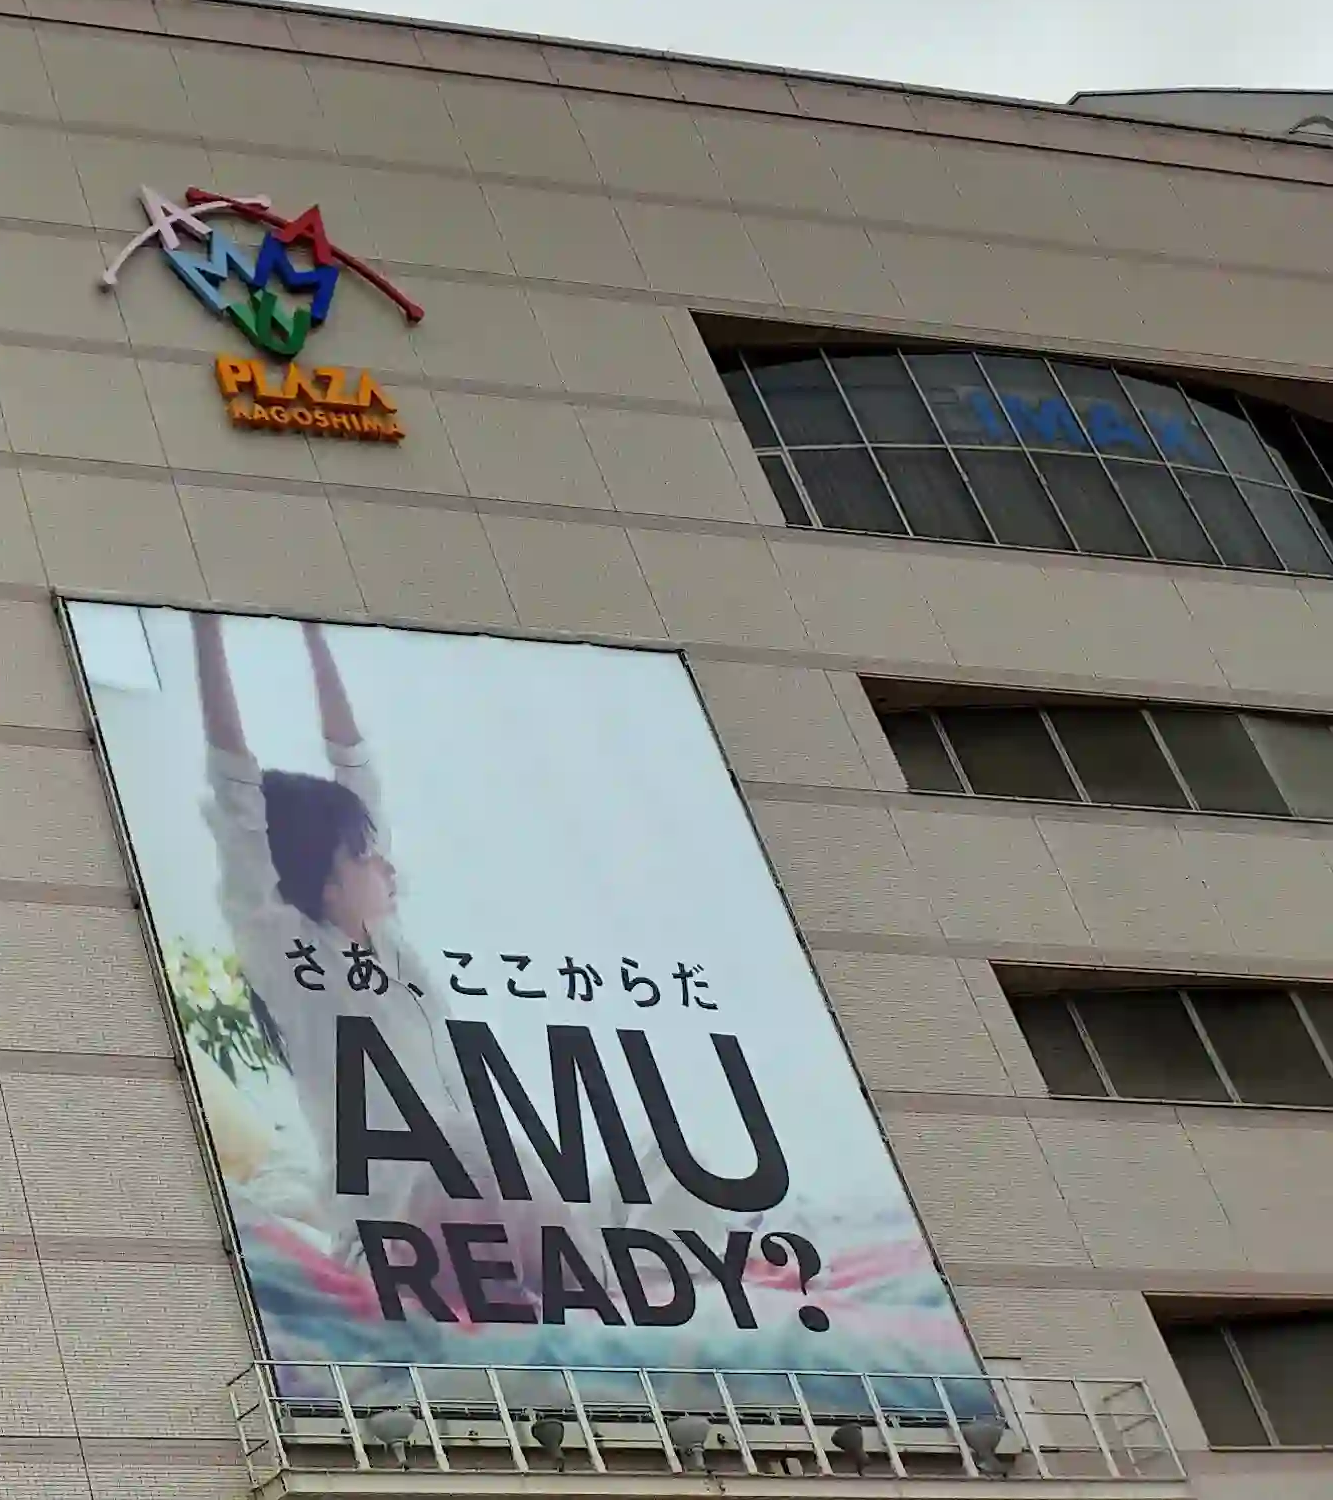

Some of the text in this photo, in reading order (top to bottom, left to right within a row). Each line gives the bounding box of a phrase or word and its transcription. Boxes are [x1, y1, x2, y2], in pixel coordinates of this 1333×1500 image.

[215, 352, 397, 414] PLAZA
[227, 398, 405, 444] KAGOSHIMA
[284, 936, 719, 1011] さあ、ここからだ
[335, 1015, 791, 1213] AMU
[354, 1218, 832, 1333] READY?
